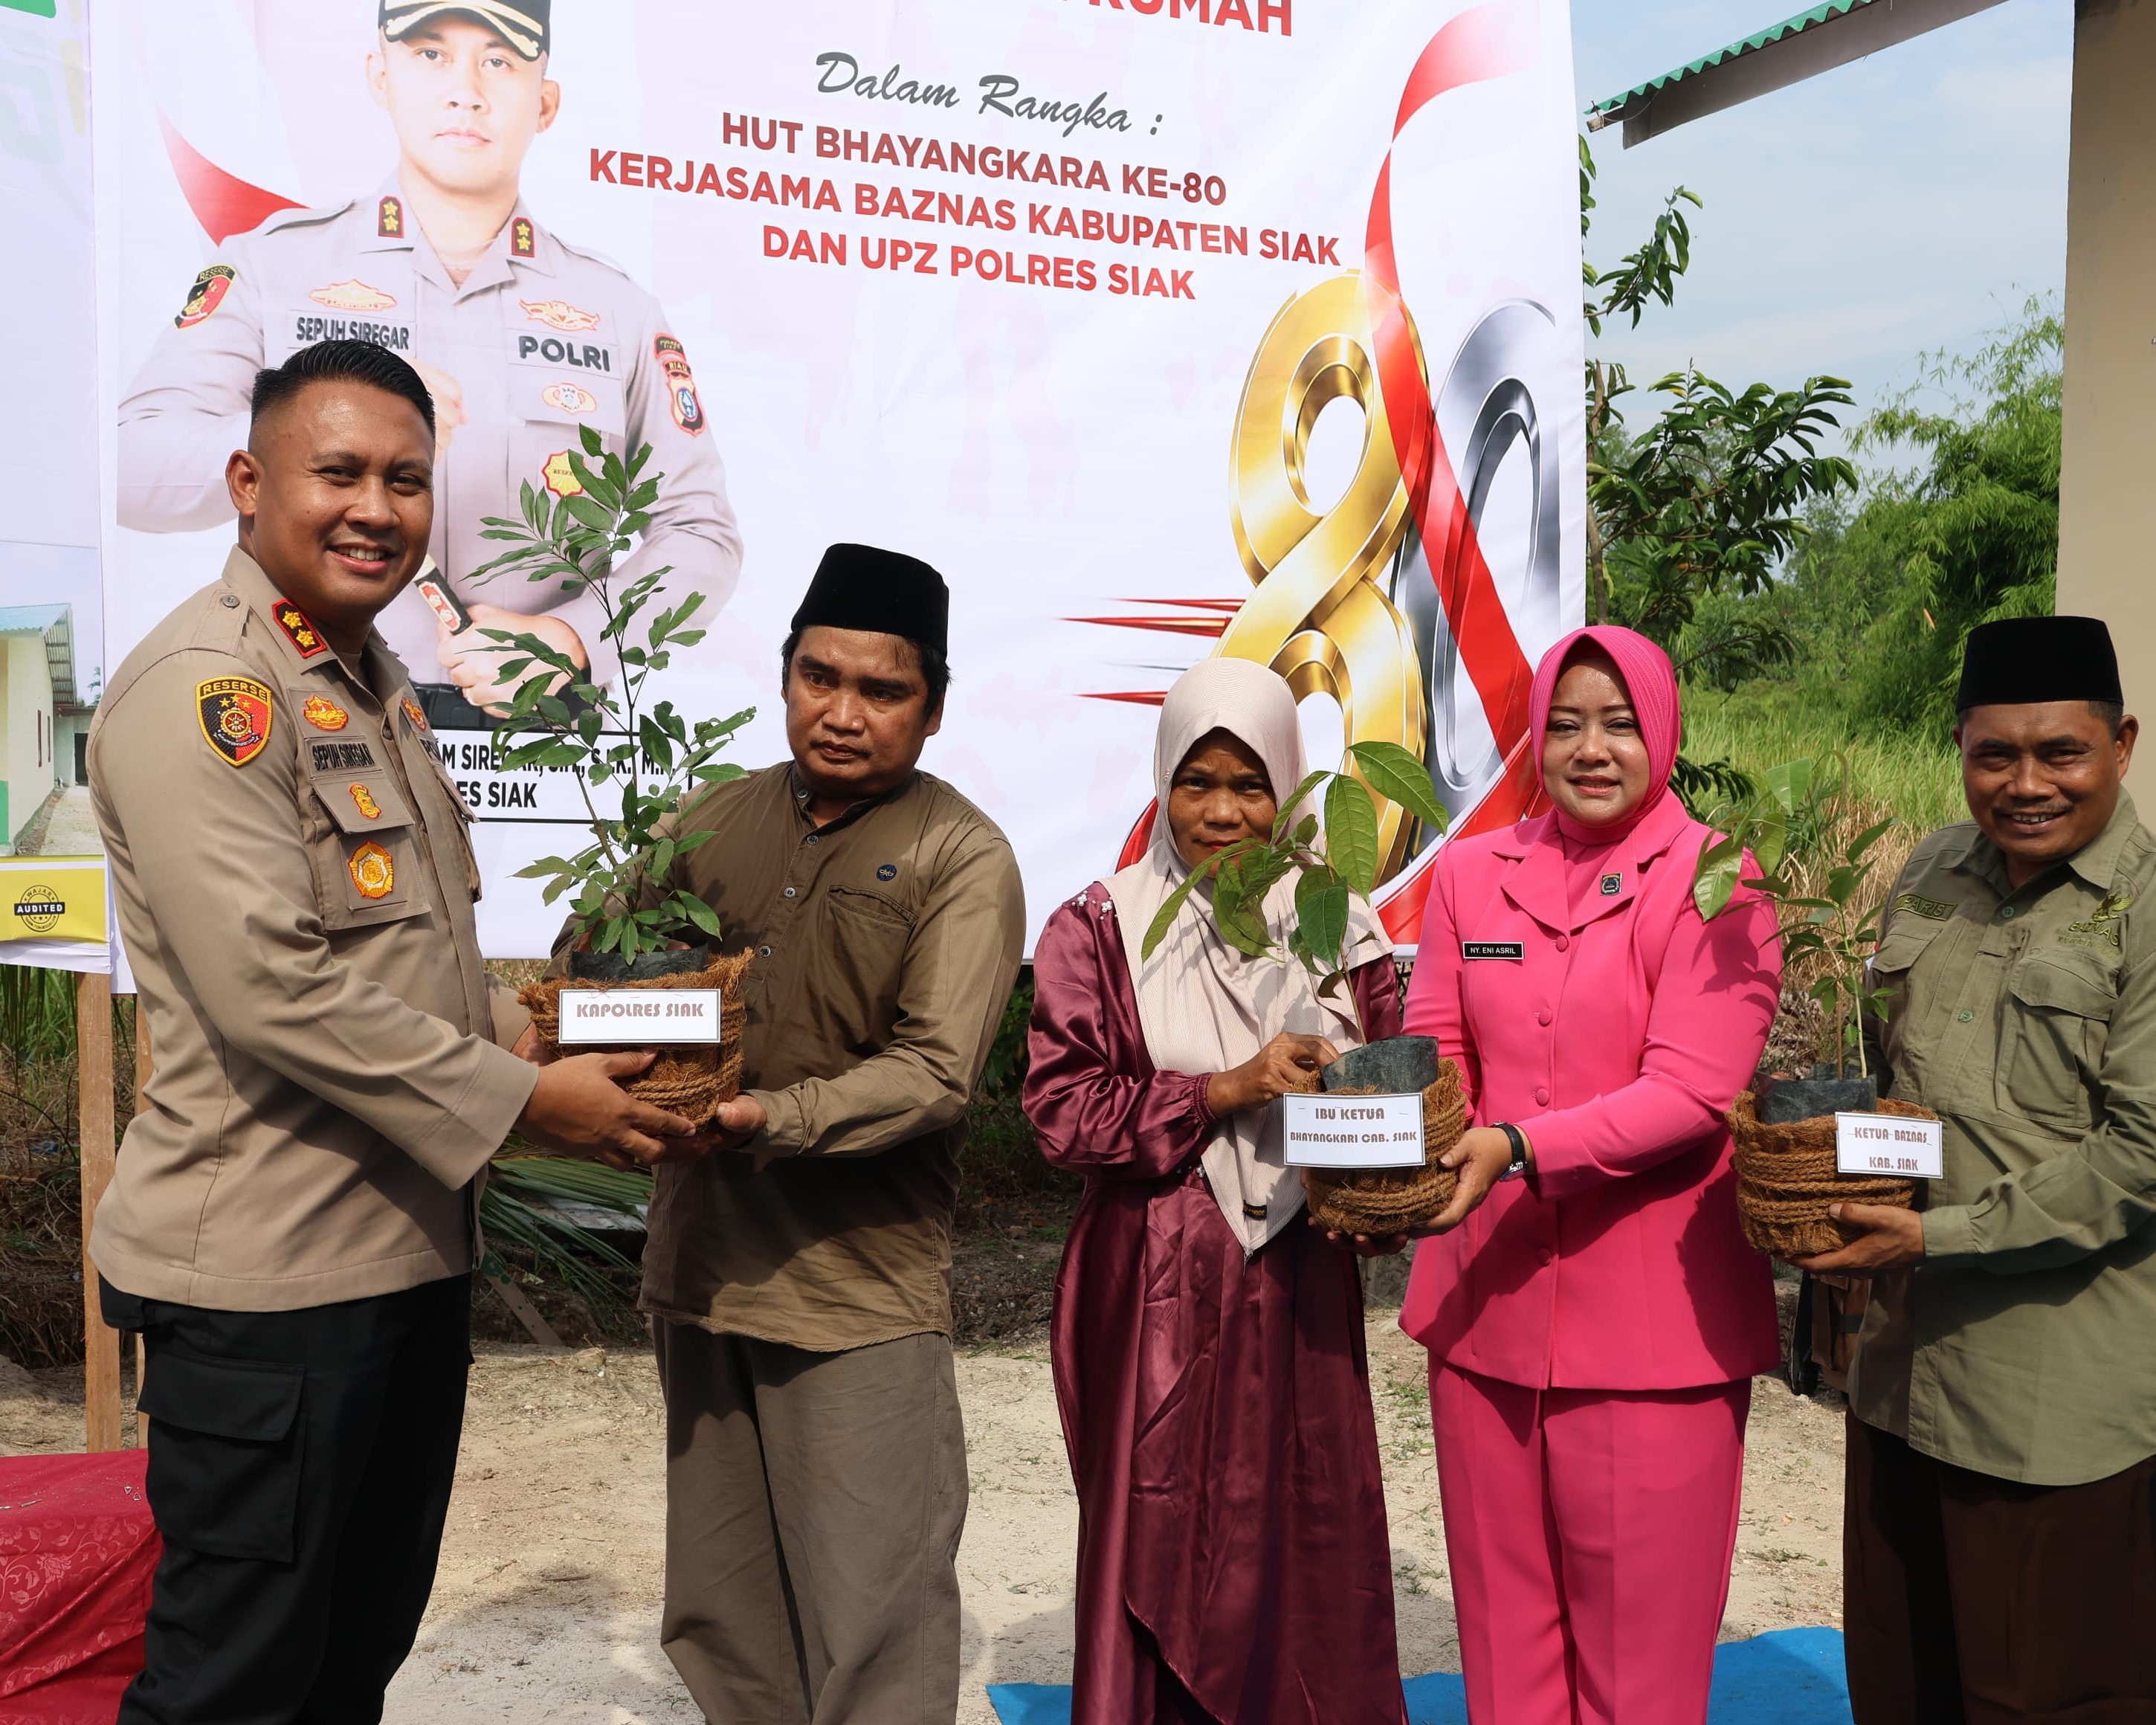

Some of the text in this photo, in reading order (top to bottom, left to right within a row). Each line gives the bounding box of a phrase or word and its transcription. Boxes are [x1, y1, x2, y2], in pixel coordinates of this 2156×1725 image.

[816, 52, 960, 108] Dalam
[978, 74, 1132, 138] Rangka
[723, 112, 1226, 205] HUT BHAYANGKARA KE-80
[590, 148, 1340, 266] KERJASAMA BAZNAS KABUPATEN SIAK
[764, 225, 1196, 300] DAN UPZ POLRES SIAK
[297, 317, 409, 350] SEPUH SIREGAR
[518, 335, 610, 372] POLRI
[202, 681, 268, 701] RESERSE
[312, 743, 375, 770] SEPUH SIREGAR
[456, 781, 538, 808] ES SIAK
[27, 888, 52, 897] WAJAR
[16, 903, 62, 913] AUDITED
[577, 1003, 703, 1017] KAPOLRES SIAK
[1315, 1108, 1384, 1120] IBU KETUA
[1290, 1132, 1417, 1143] BHAYANGKARI CAB. SIAK
[1854, 1127, 1927, 1144] KETUA BAZNAS
[1869, 1156, 1919, 1171] KAB. SIAK
